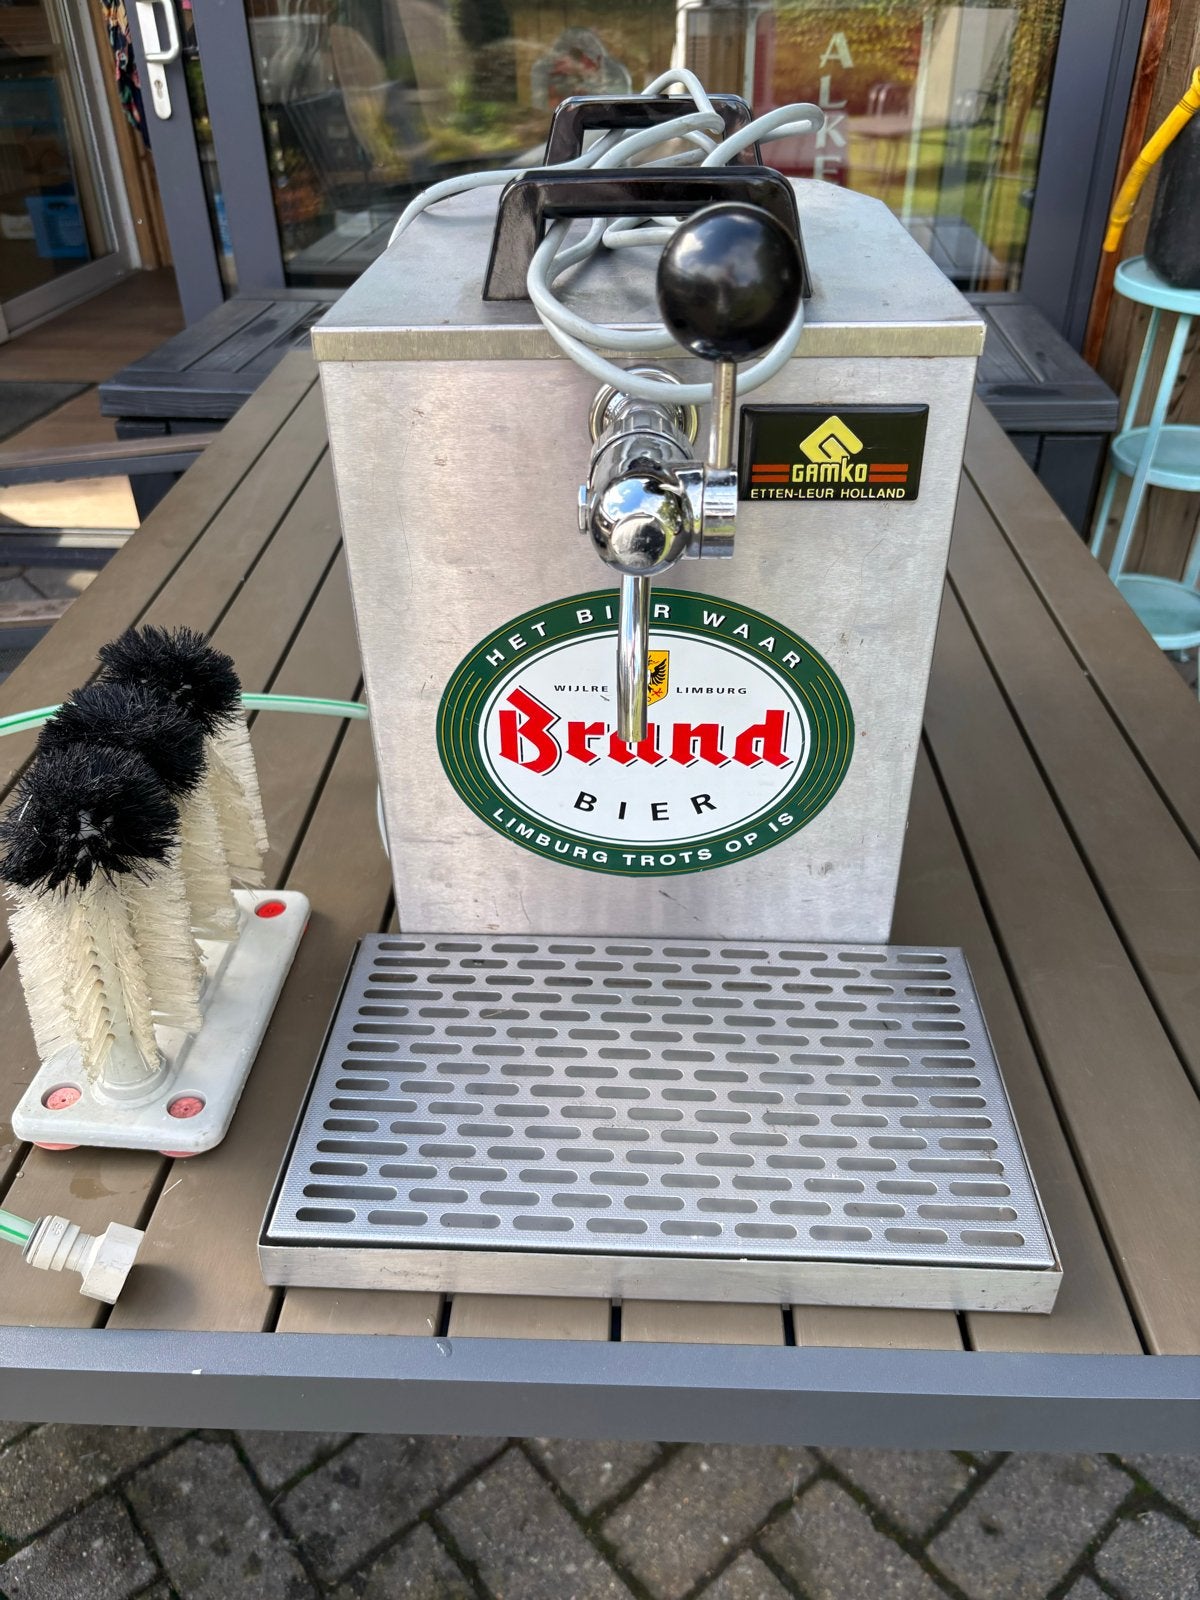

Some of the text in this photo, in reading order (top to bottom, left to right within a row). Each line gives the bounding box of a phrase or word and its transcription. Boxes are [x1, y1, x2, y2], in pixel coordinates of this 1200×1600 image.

[750, 488, 906, 499] ETTEN-LEUR HOLLAND
[485, 603, 801, 669] HET BIR WAAR
[554, 685, 747, 695] WIJLRE LIMBURG
[498, 687, 793, 775] Brand
[573, 791, 717, 821] BIER
[492, 808, 794, 867] LIMBURG TROTS OP IS
